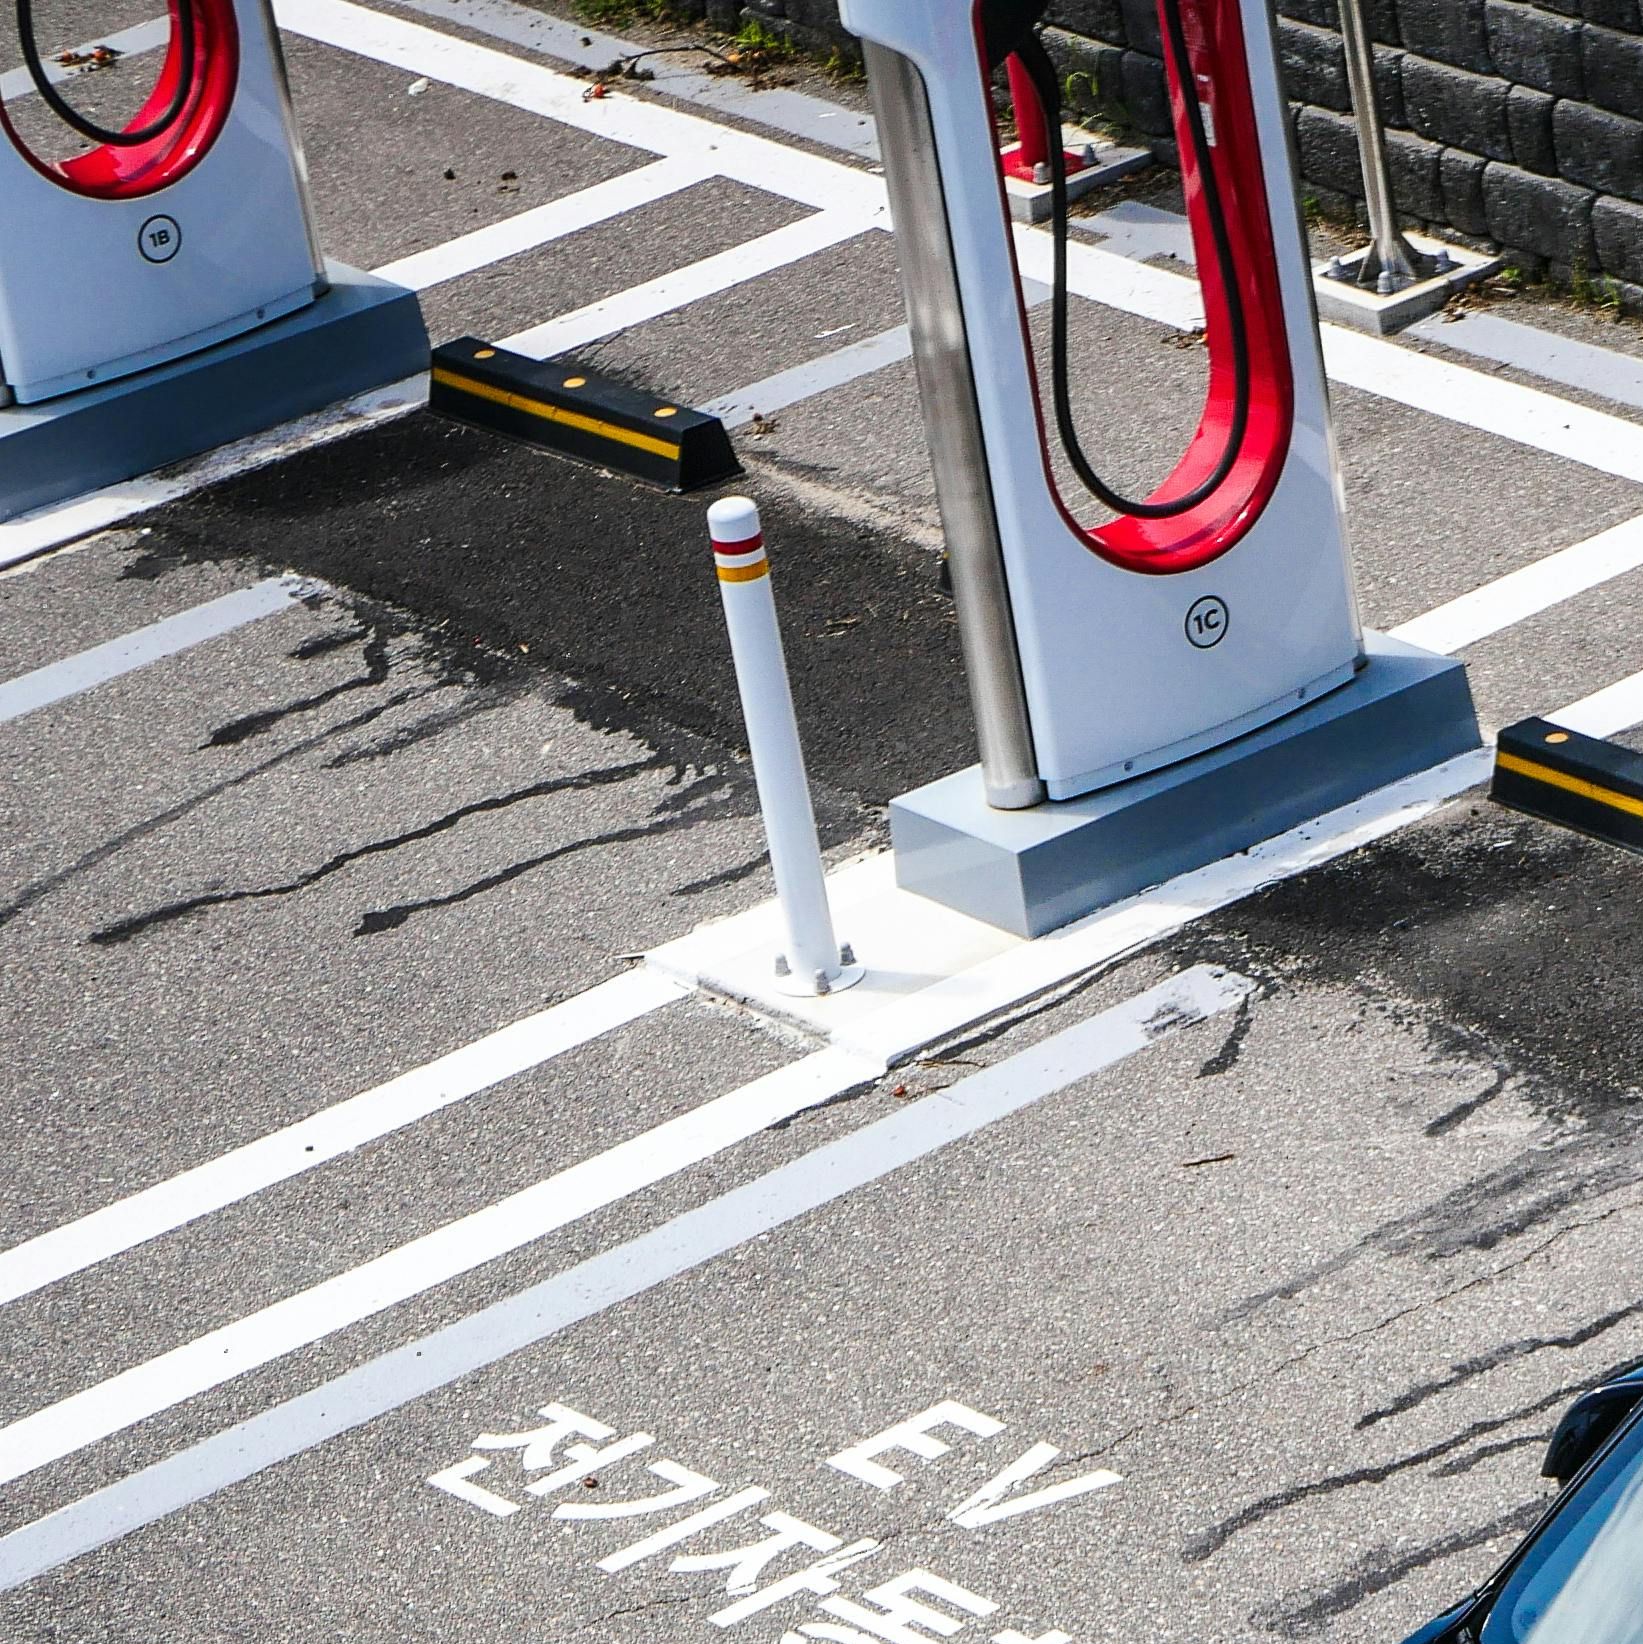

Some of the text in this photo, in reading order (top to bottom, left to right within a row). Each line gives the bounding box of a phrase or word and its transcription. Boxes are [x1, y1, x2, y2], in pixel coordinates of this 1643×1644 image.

[149, 229, 170, 247] 1B
[1193, 609, 1220, 634] 1C
[824, 1400, 1123, 1529] EV
